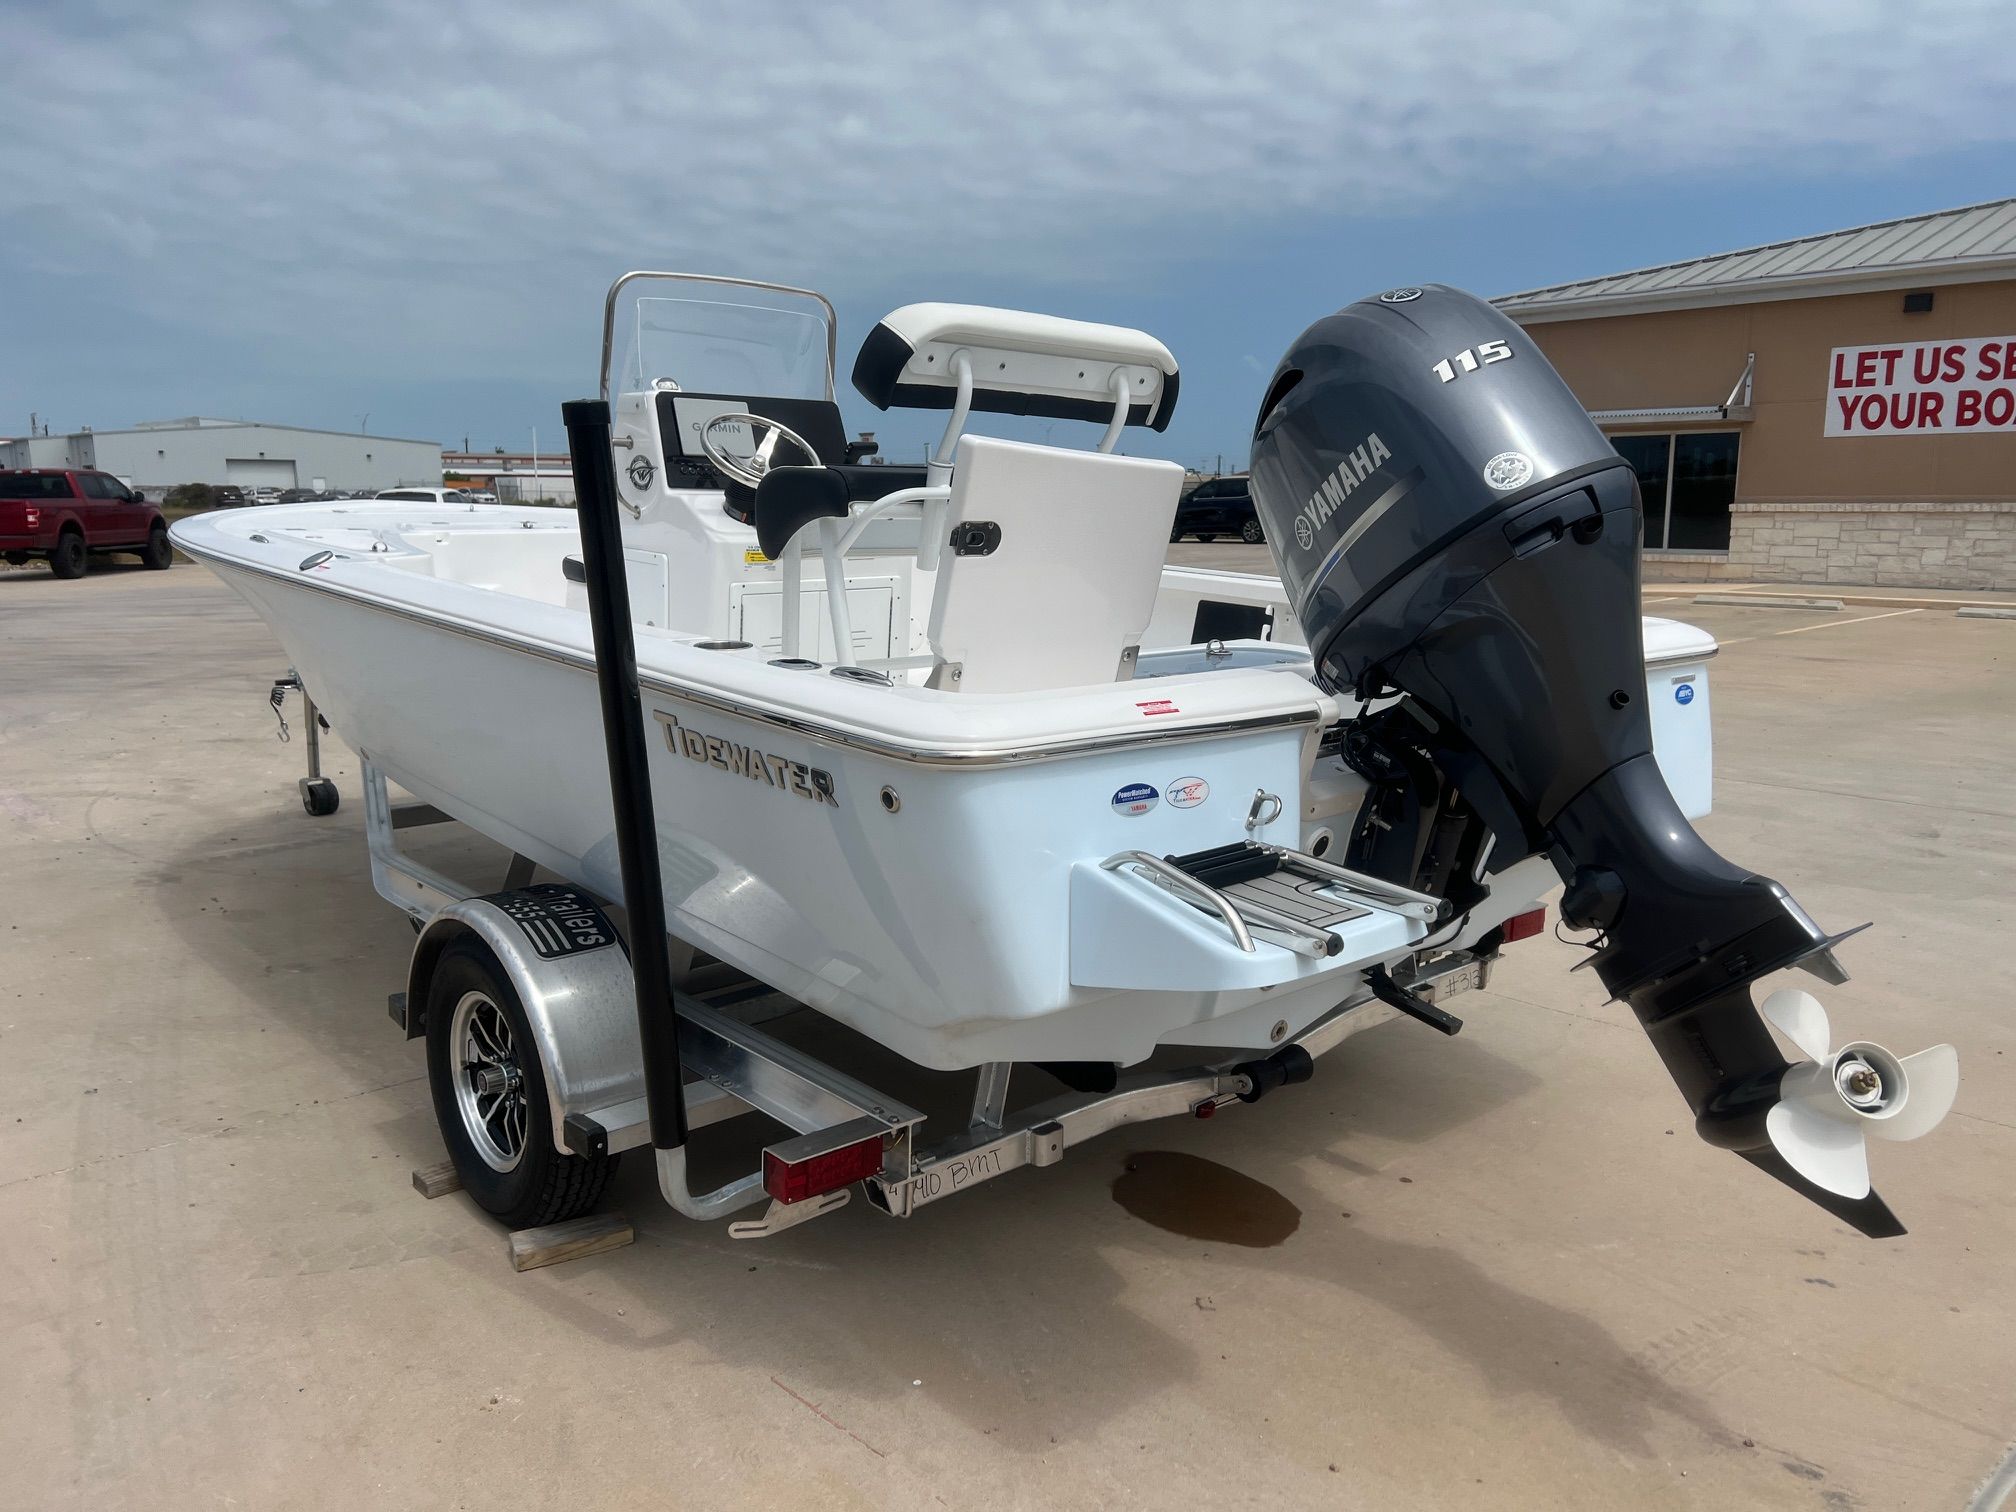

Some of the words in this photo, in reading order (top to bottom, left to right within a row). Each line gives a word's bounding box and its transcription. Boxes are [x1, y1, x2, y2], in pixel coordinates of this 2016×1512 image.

[1432, 340, 1512, 383] 115
[1834, 350, 1904, 389] LET
[1914, 345, 1967, 385] US
[692, 422, 741, 434] GRMIN
[1838, 391, 1944, 431] YOUR
[1955, 387, 2016, 427] BO
[1304, 432, 1392, 531] YAMAHA
[653, 709, 839, 808] TIDEWATER
[947, 1148, 1001, 1189] BMT
